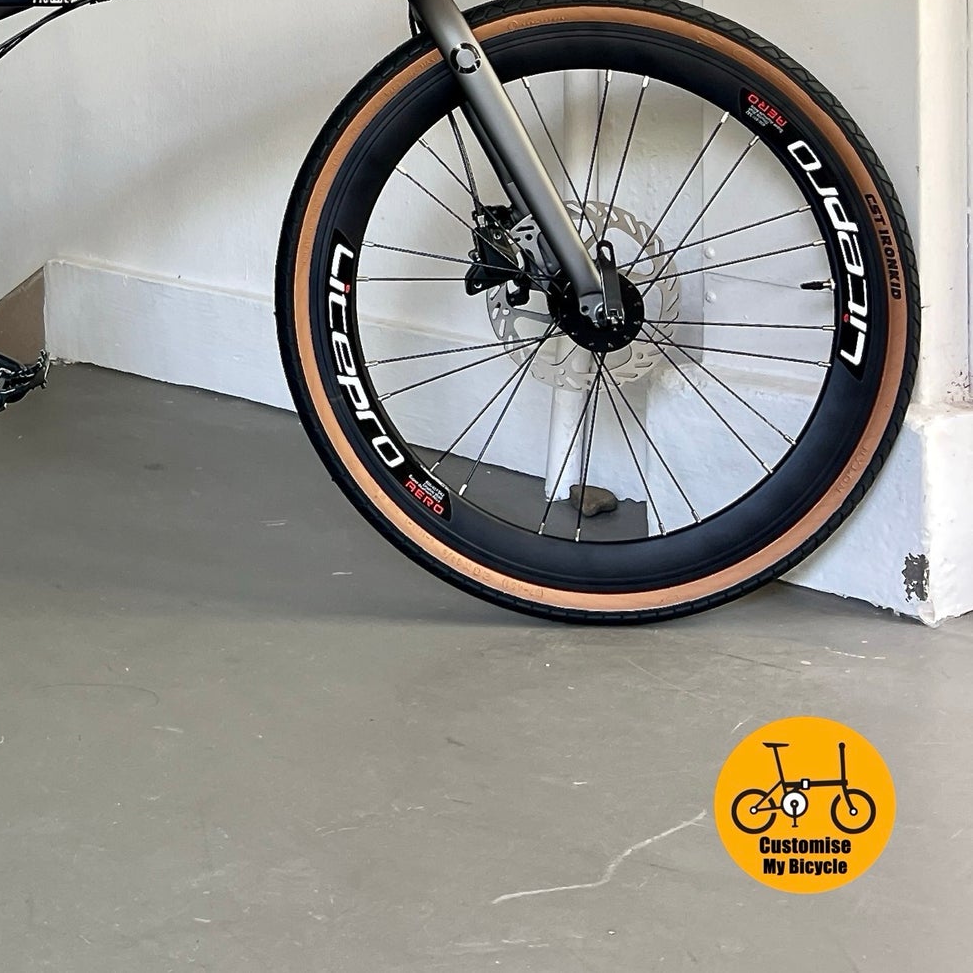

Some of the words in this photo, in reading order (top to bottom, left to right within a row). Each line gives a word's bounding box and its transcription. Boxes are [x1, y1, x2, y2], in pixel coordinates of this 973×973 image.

[747, 94, 787, 127] AERO
[787, 140, 869, 366] Litepro
[864, 193, 886, 227] CST
[879, 229, 902, 300] IRONKID
[329, 243, 405, 468] Litepro
[405, 480, 444, 515] AERO
